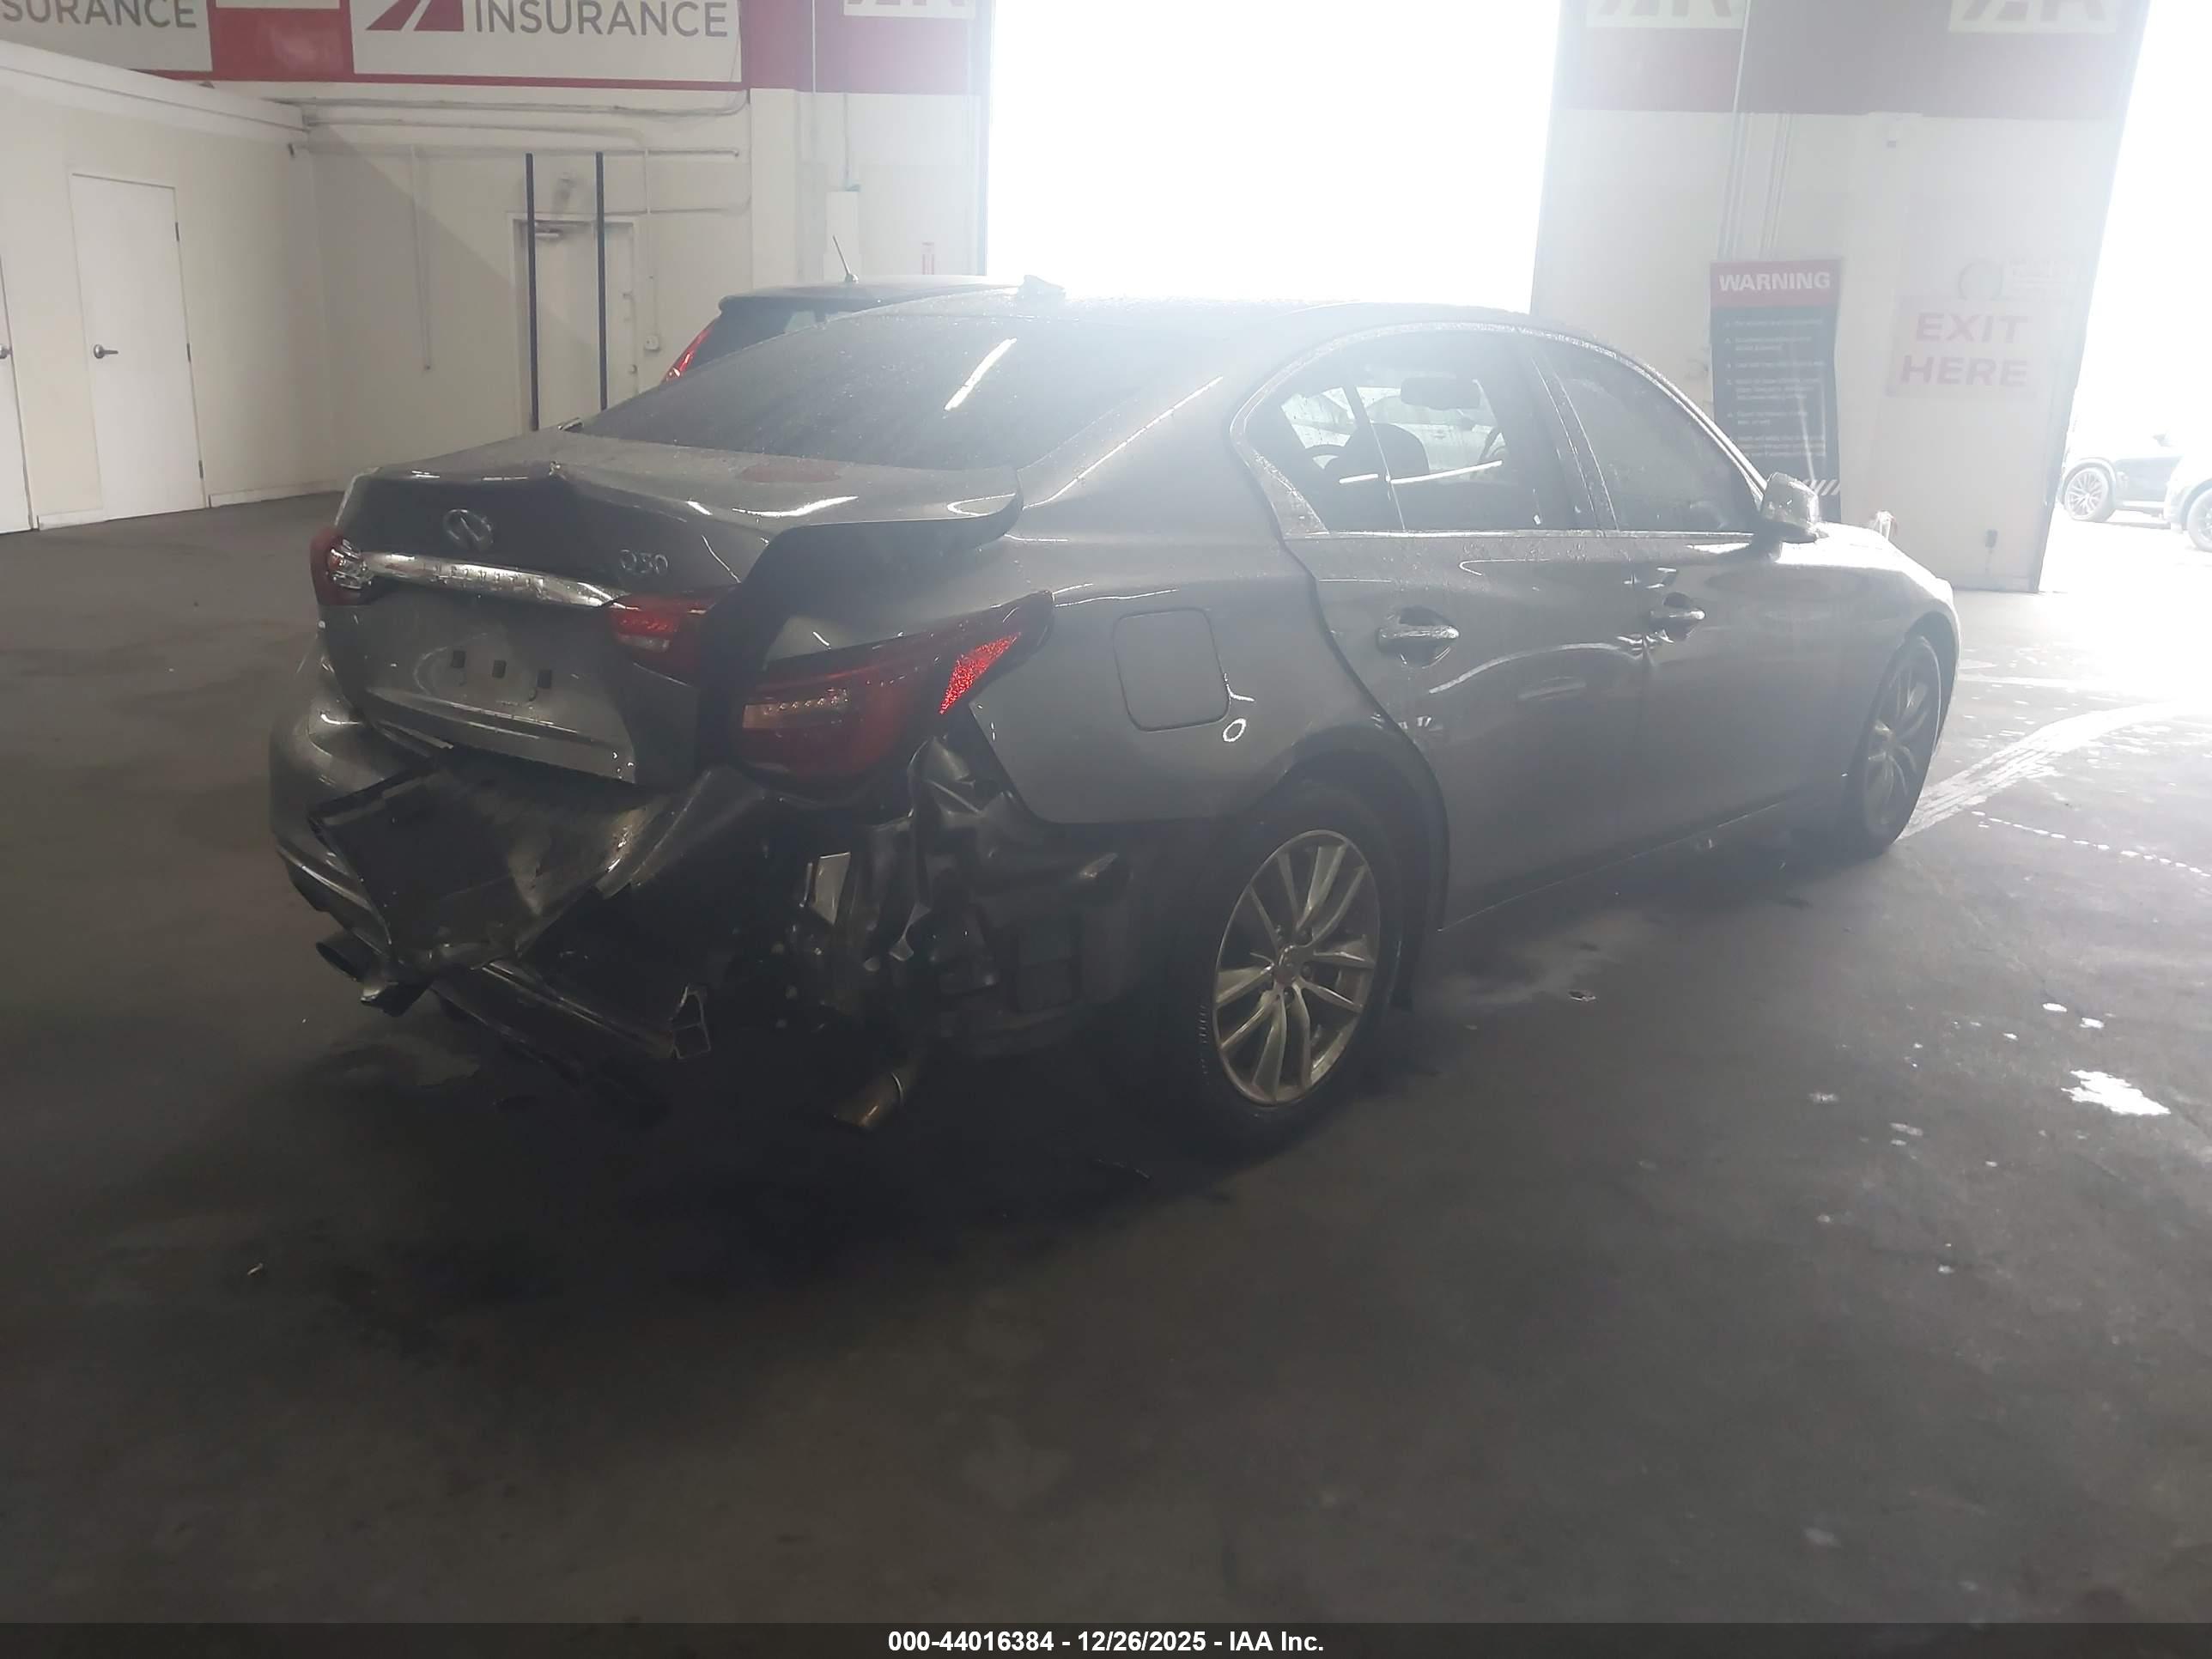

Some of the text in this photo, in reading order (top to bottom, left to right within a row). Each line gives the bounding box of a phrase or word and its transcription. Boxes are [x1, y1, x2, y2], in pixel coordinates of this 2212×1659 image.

[474, 0, 728, 38] INSURANCE
[1718, 271, 1831, 291] WARNING
[1915, 312, 2028, 343] EXIT
[1899, 354, 2028, 387] HERE
